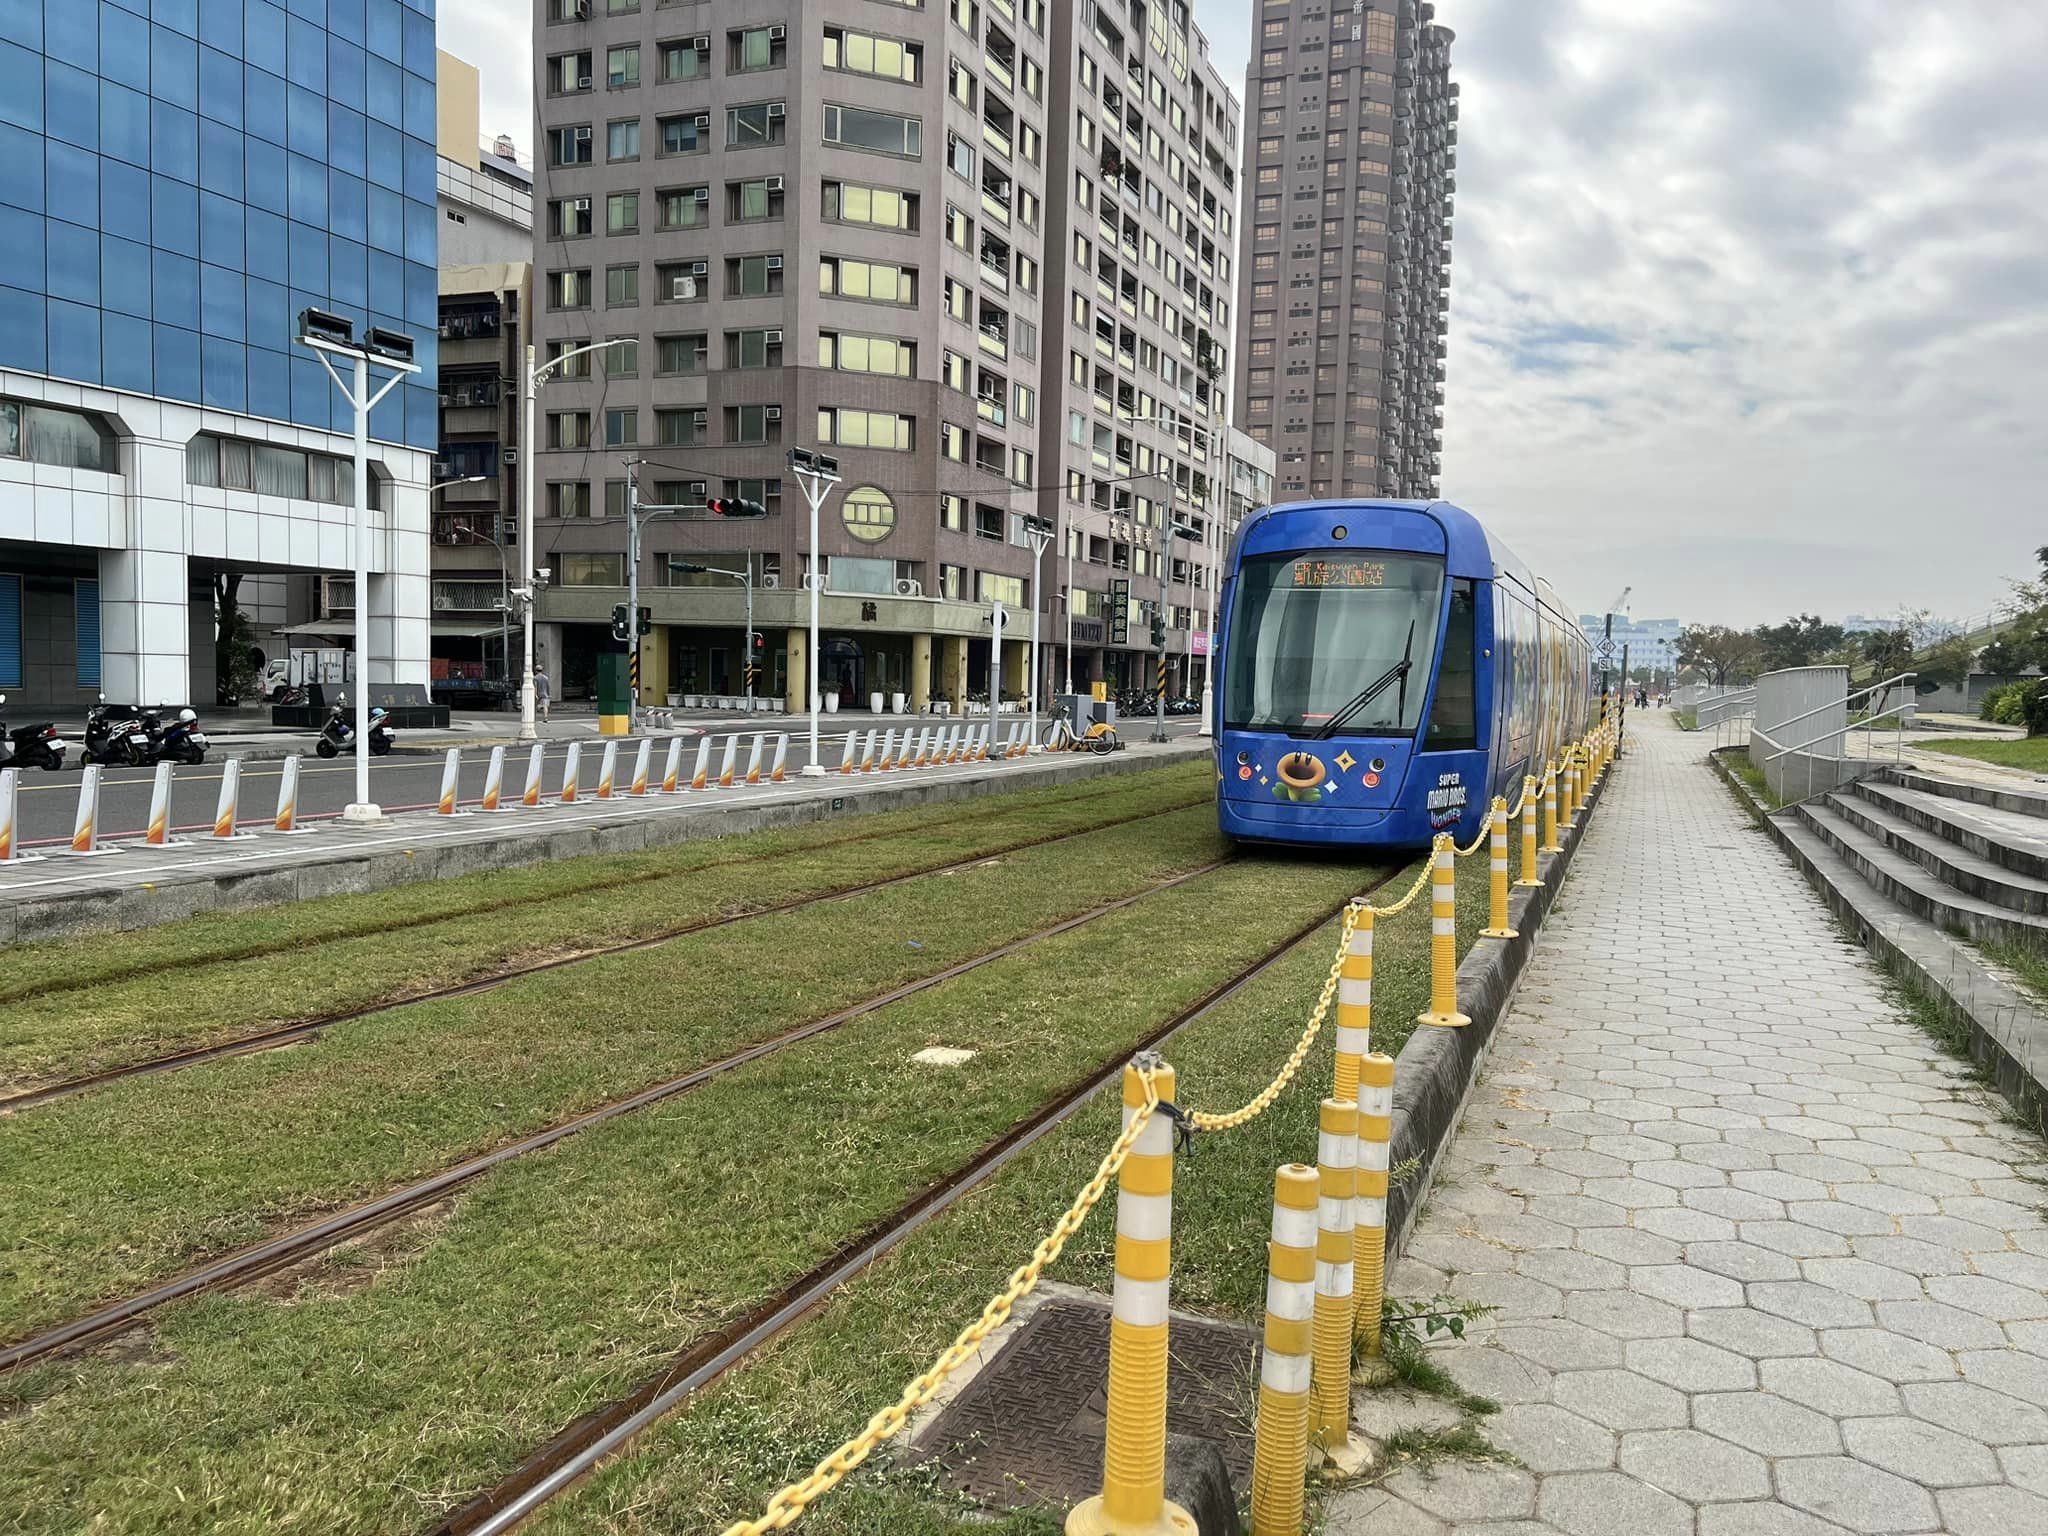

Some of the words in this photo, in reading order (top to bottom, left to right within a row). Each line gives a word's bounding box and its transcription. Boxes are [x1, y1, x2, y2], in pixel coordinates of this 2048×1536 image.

[1601, 642, 1611, 651] 40
[1600, 659, 1609, 669] SL
[1439, 772, 1460, 787] SUPER
[1427, 789, 1449, 809] MARIO
